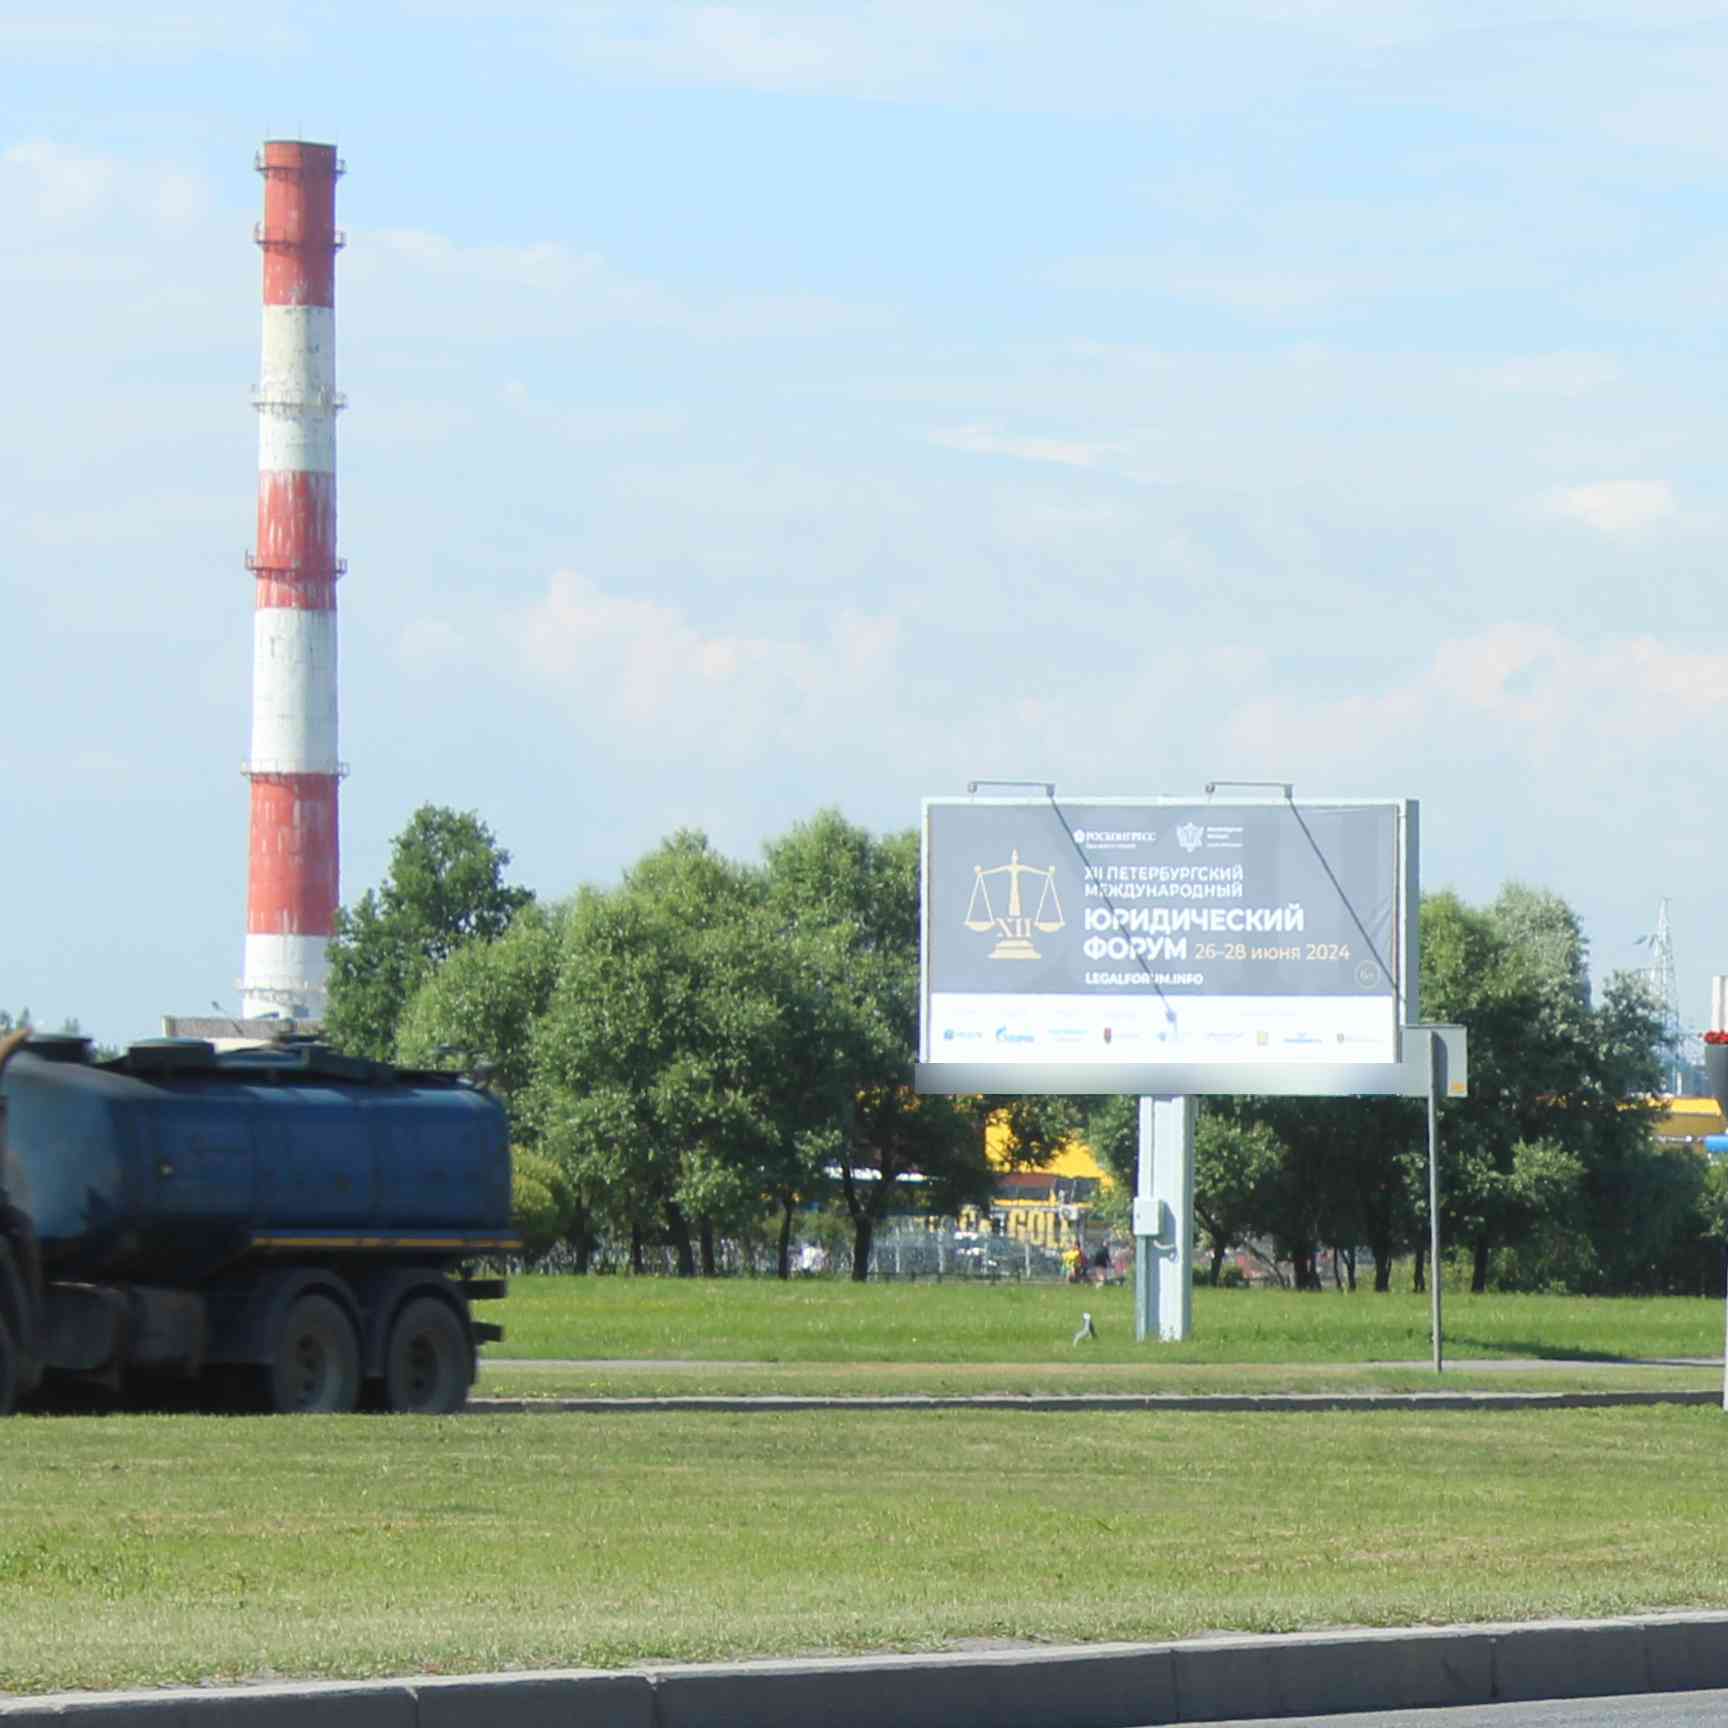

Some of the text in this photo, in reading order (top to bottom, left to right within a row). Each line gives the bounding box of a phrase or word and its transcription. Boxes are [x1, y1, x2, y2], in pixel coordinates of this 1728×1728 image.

[1107, 864, 1244, 881] ПЕТЕРБУРГСКИЙ
[1084, 881, 1243, 899] МЕЖДУНАРОДНЫЙ
[1084, 903, 1304, 934] ЮРИДИЧЕСКИЙ
[1083, 935, 1187, 961] ФОРУМ
[1252, 946, 1300, 960] июня
[1306, 944, 1351, 960] 2024
[1085, 972, 1204, 985] LEGALFORUM.INFO
